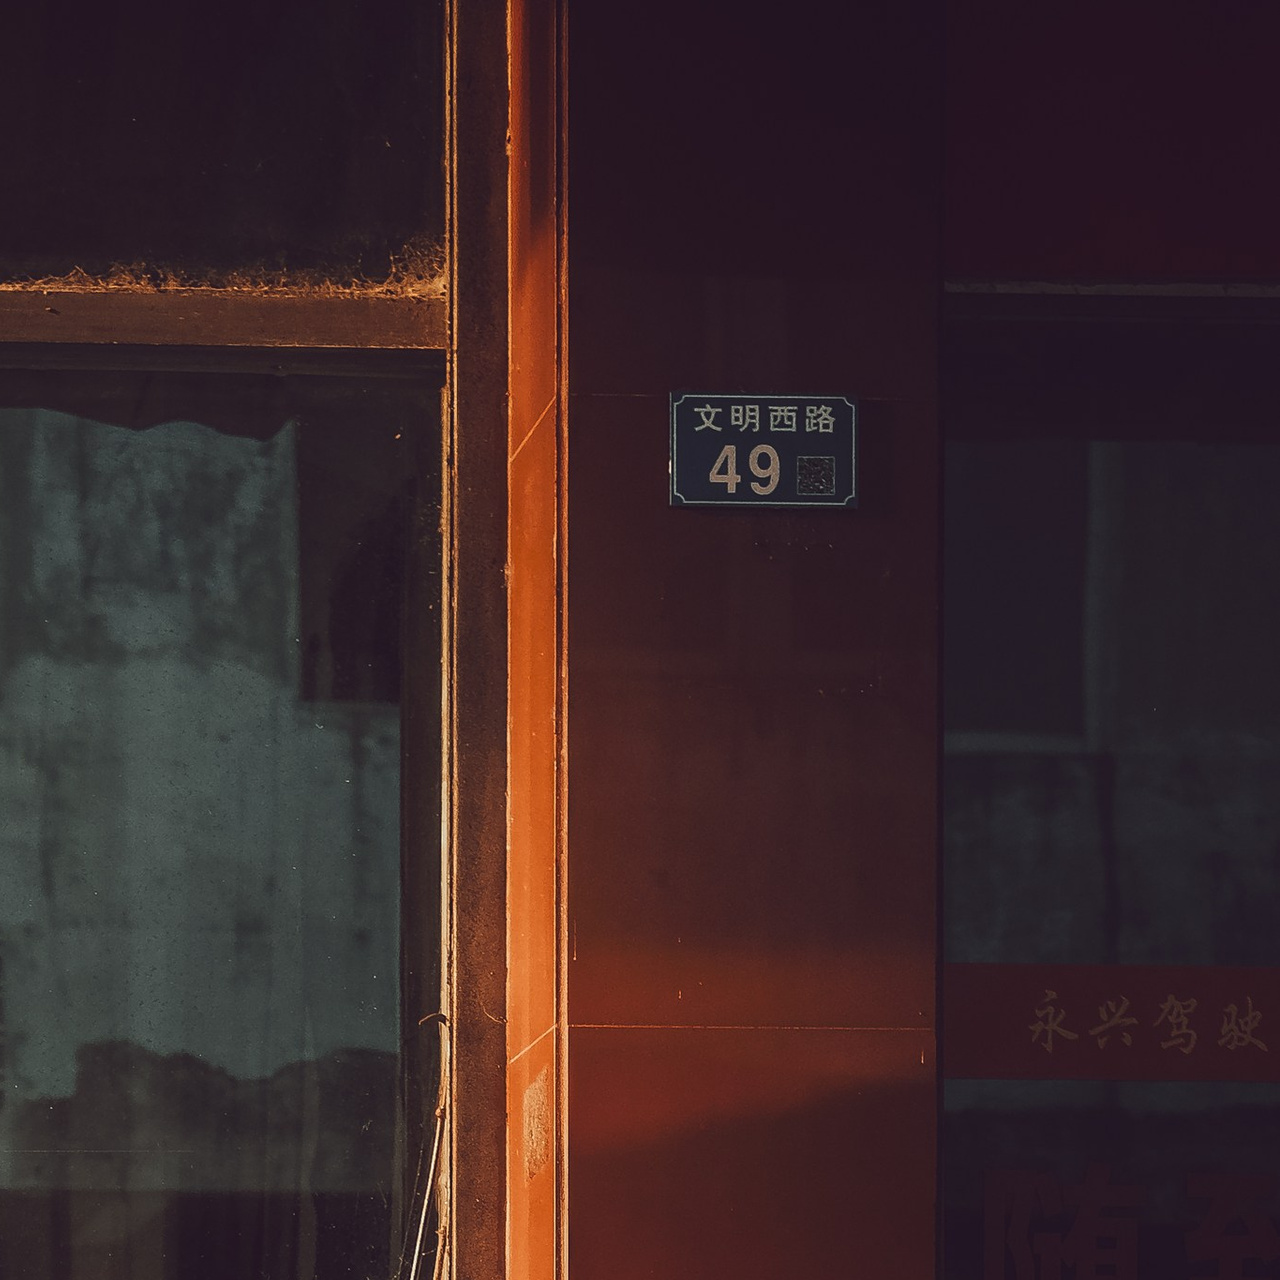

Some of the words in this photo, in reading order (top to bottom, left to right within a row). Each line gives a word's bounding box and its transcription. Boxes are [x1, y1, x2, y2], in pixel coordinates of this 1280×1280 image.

[693, 403, 836, 433] 文明西路
[709, 444, 781, 495] 49
[1027, 989, 1269, 1055] 永兴驾驶
